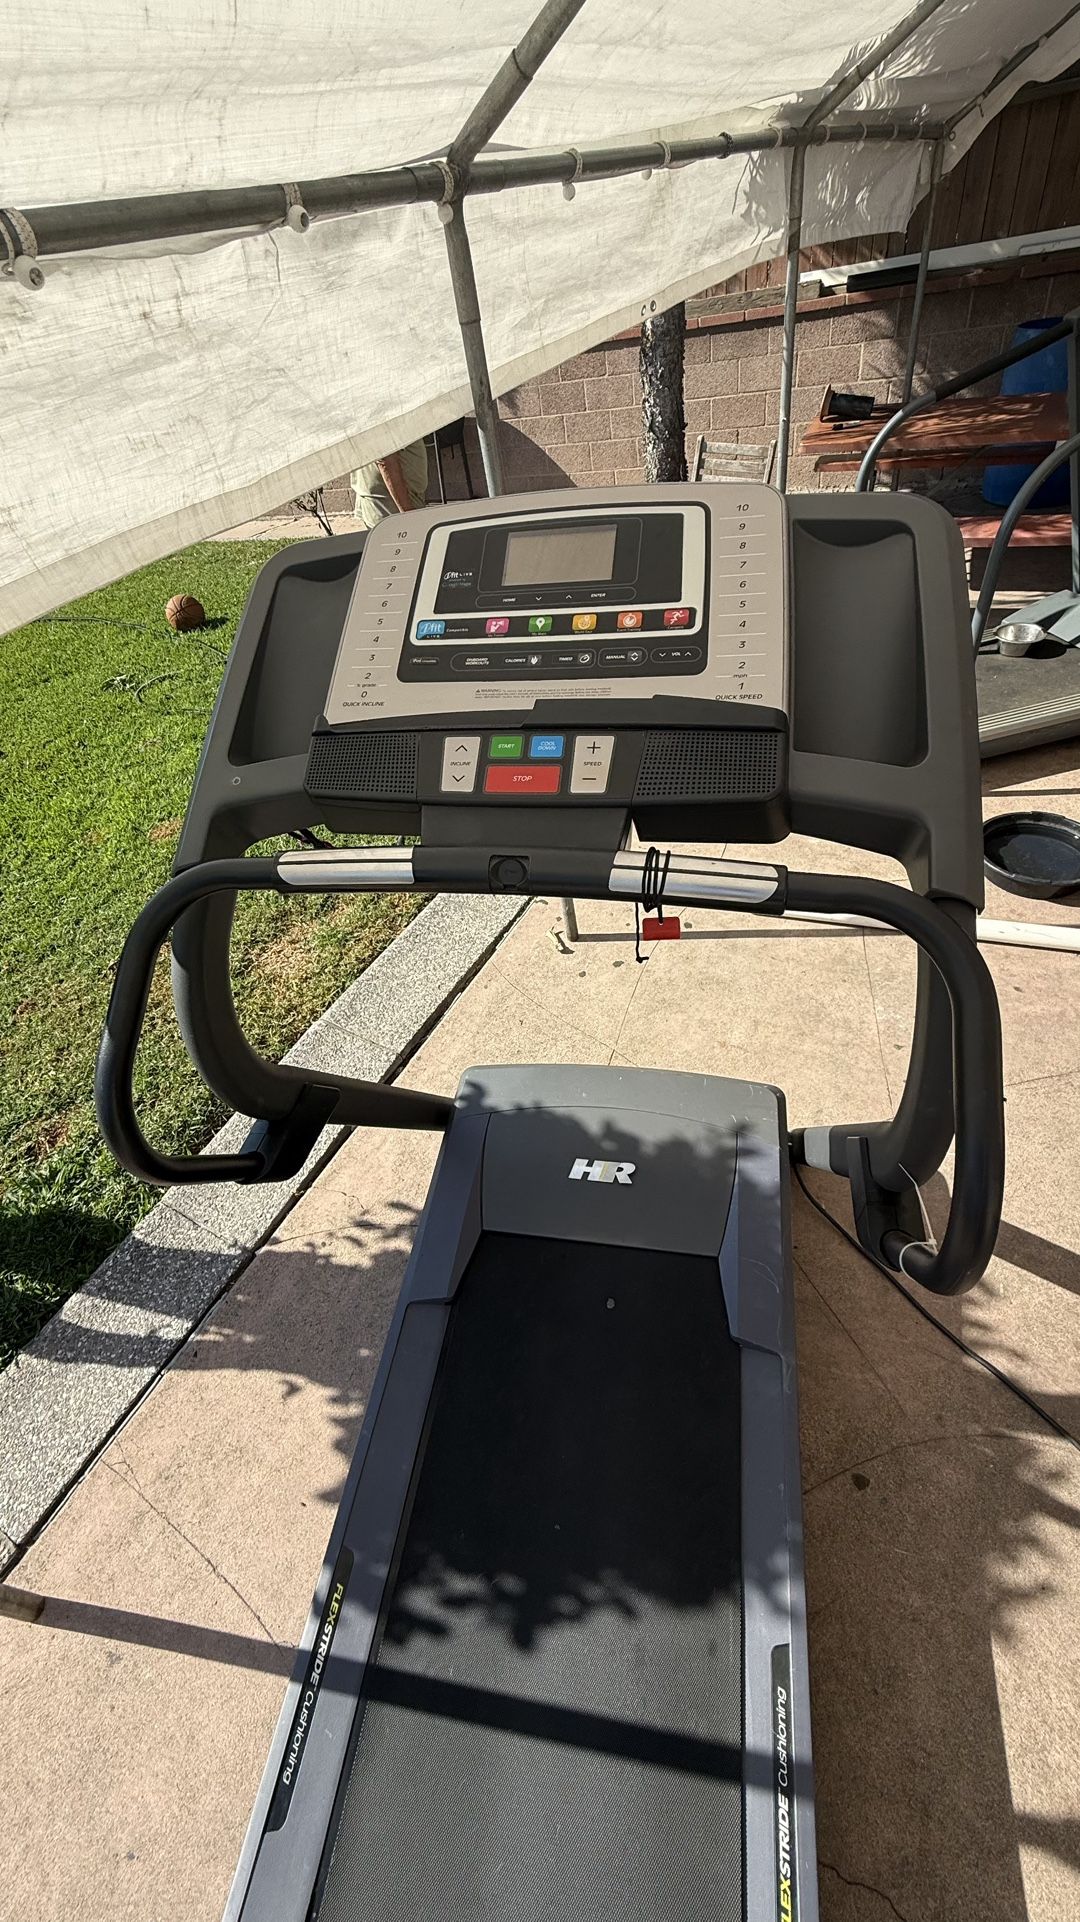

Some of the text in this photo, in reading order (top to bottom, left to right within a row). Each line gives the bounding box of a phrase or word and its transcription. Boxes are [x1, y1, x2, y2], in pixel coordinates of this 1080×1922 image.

[736, 503, 750, 512] 10
[738, 522, 746, 531] 9
[397, 531, 408, 540] 10
[739, 541, 747, 550] 8
[394, 549, 401, 557] 9
[389, 565, 397, 573] 8
[739, 560, 747, 569] 7
[386, 582, 393, 591] 7
[739, 580, 747, 589] 6
[381, 600, 388, 608] 6
[739, 600, 747, 608] 5
[377, 618, 384, 626] 5
[738, 620, 747, 629] 4
[738, 640, 747, 649] 3
[368, 654, 376, 662] 3
[738, 661, 746, 670] 2
[364, 672, 372, 680] 2
[738, 682, 744, 690] 1
[361, 690, 368, 698] 0
[512, 775, 533, 783] STOP
[282, 1583, 343, 1786] FLEXSTRIDE Cushioning
[777, 1685, 791, 1922] LEXSTRIDE Cushioning
